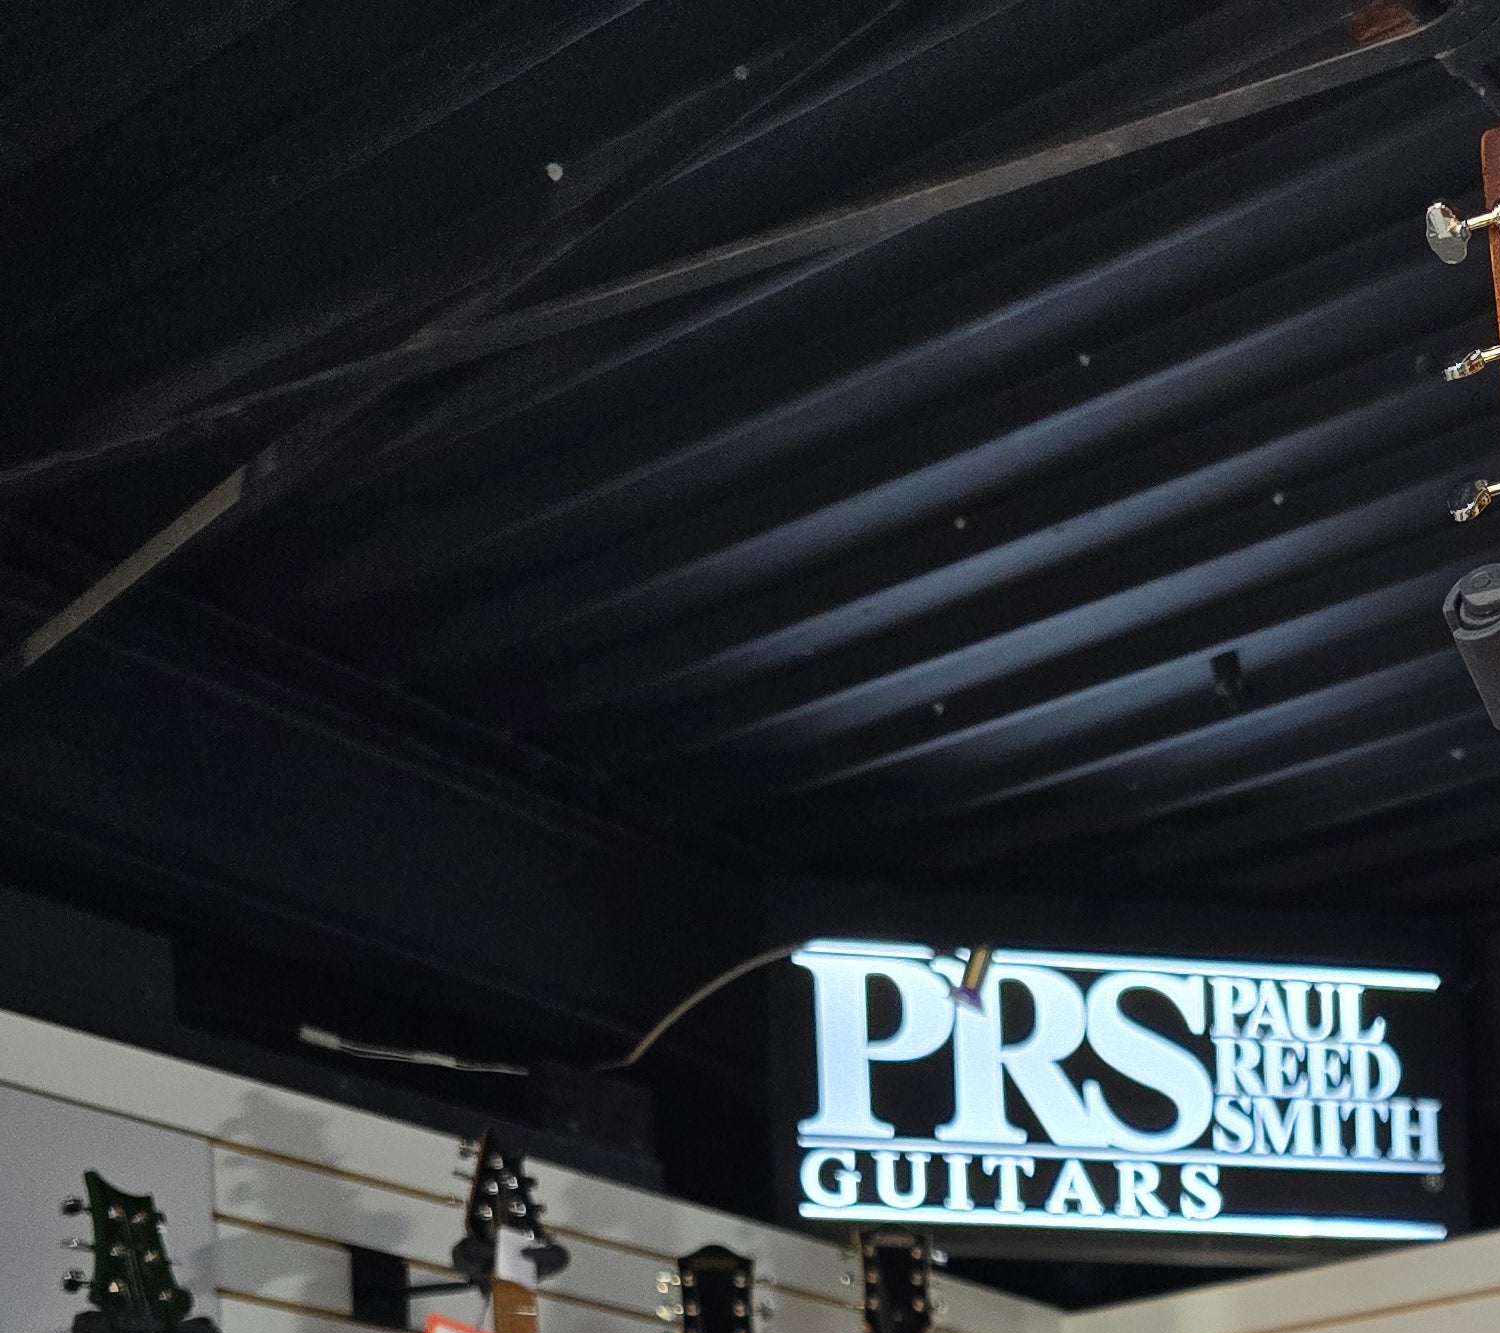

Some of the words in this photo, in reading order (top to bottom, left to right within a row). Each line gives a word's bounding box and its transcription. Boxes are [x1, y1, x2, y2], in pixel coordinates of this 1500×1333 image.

[1210, 976, 1386, 1044] PAUL
[792, 950, 1214, 1153] PRS
[1211, 1036, 1401, 1102] REED
[1213, 1096, 1443, 1162] SMITH
[801, 1149, 1224, 1220] GUITARS
